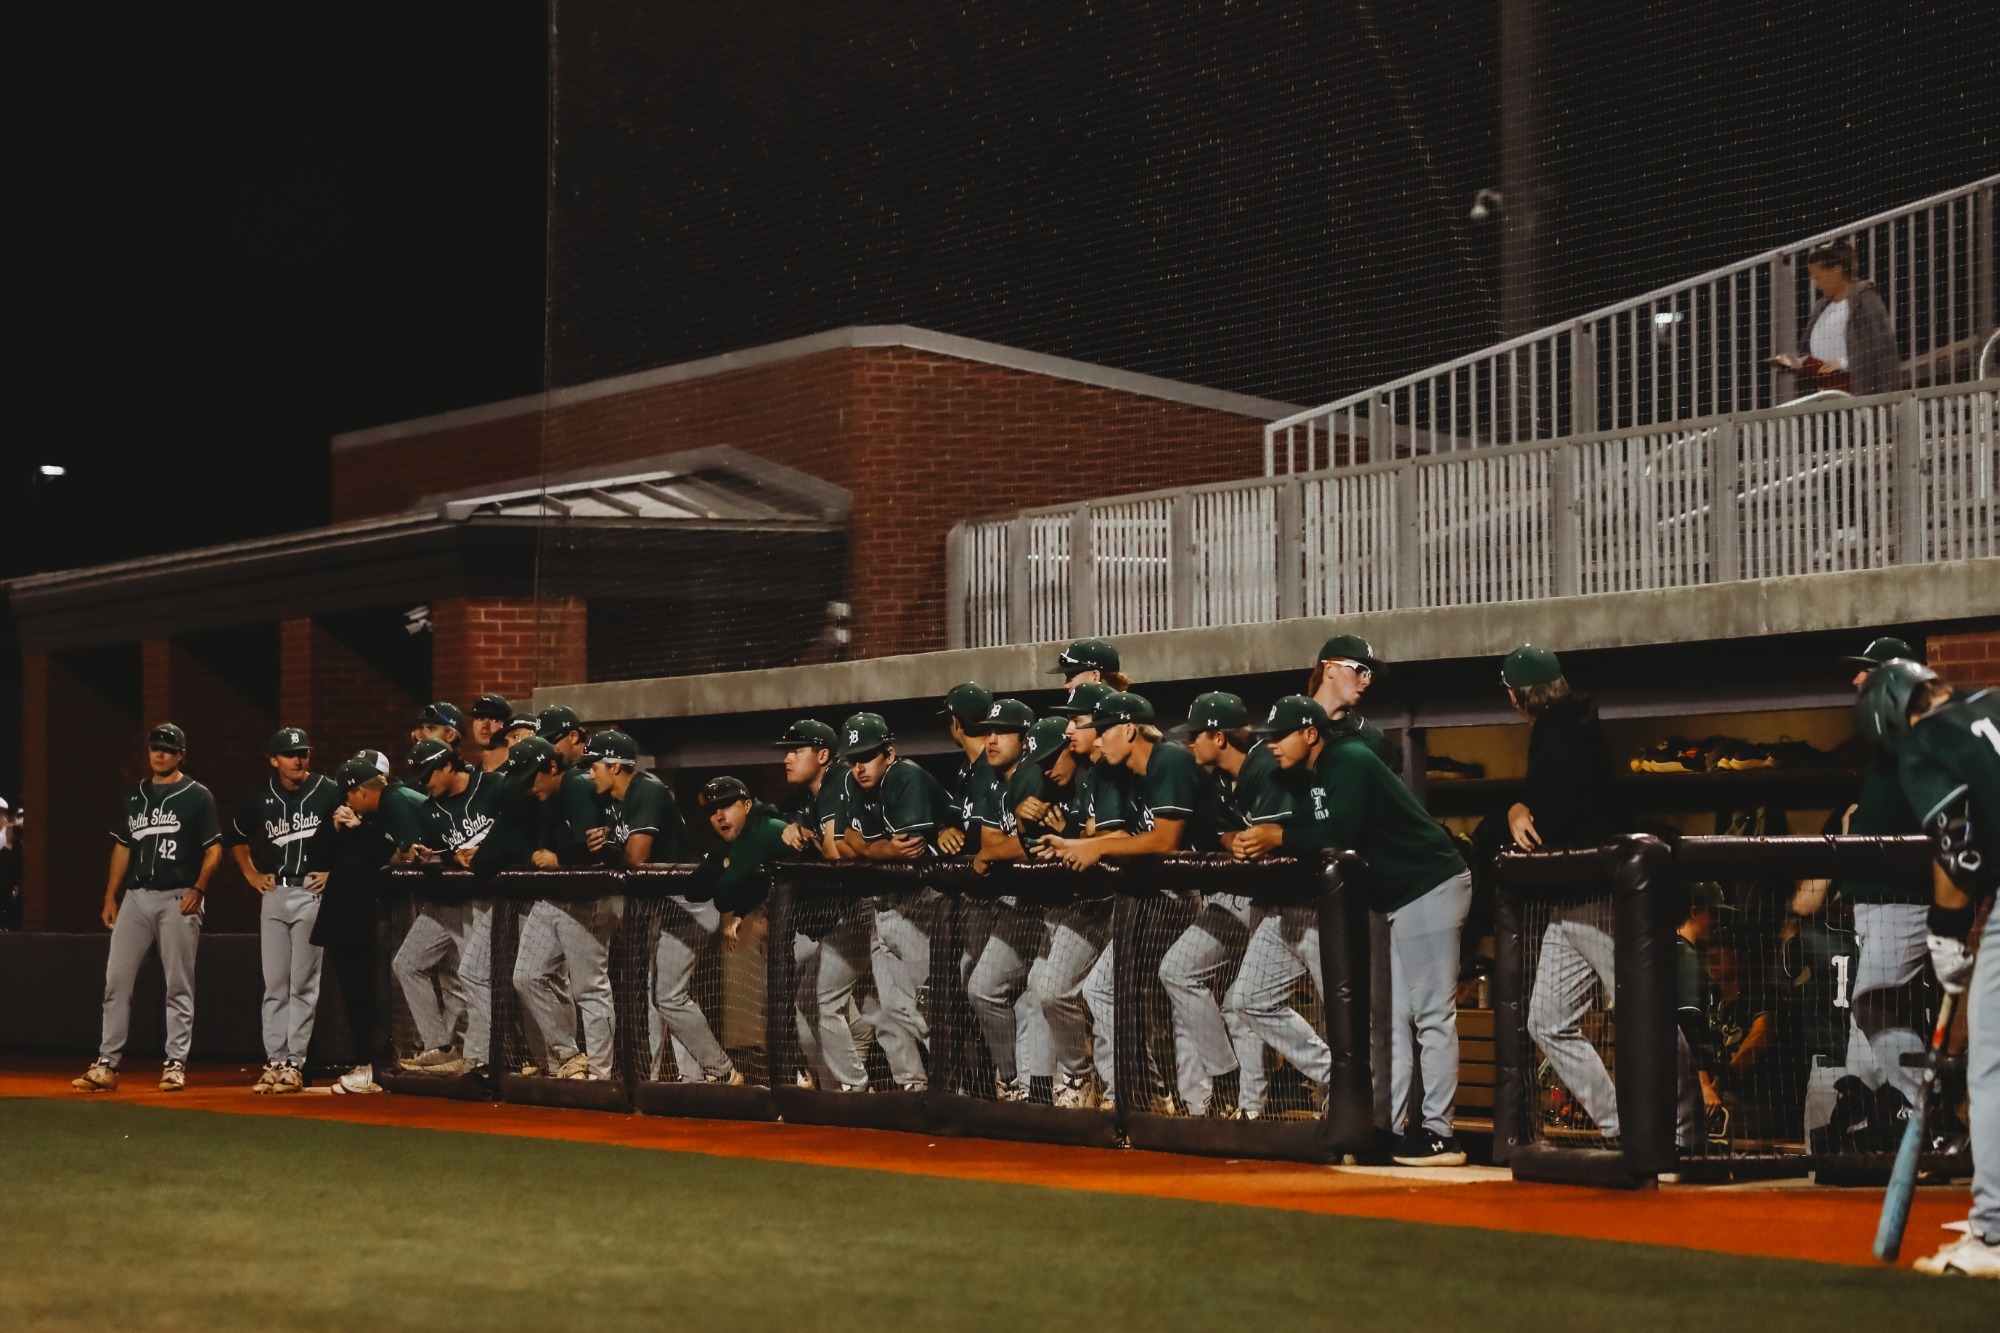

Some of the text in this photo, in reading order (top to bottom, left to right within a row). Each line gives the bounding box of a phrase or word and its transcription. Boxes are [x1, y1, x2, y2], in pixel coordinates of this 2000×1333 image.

[128, 808, 177, 833] Delta State
[265, 811, 322, 839] Delta State
[462, 812, 488, 836] State
[158, 838, 177, 860] 42
[1831, 955, 1850, 1008] 1
